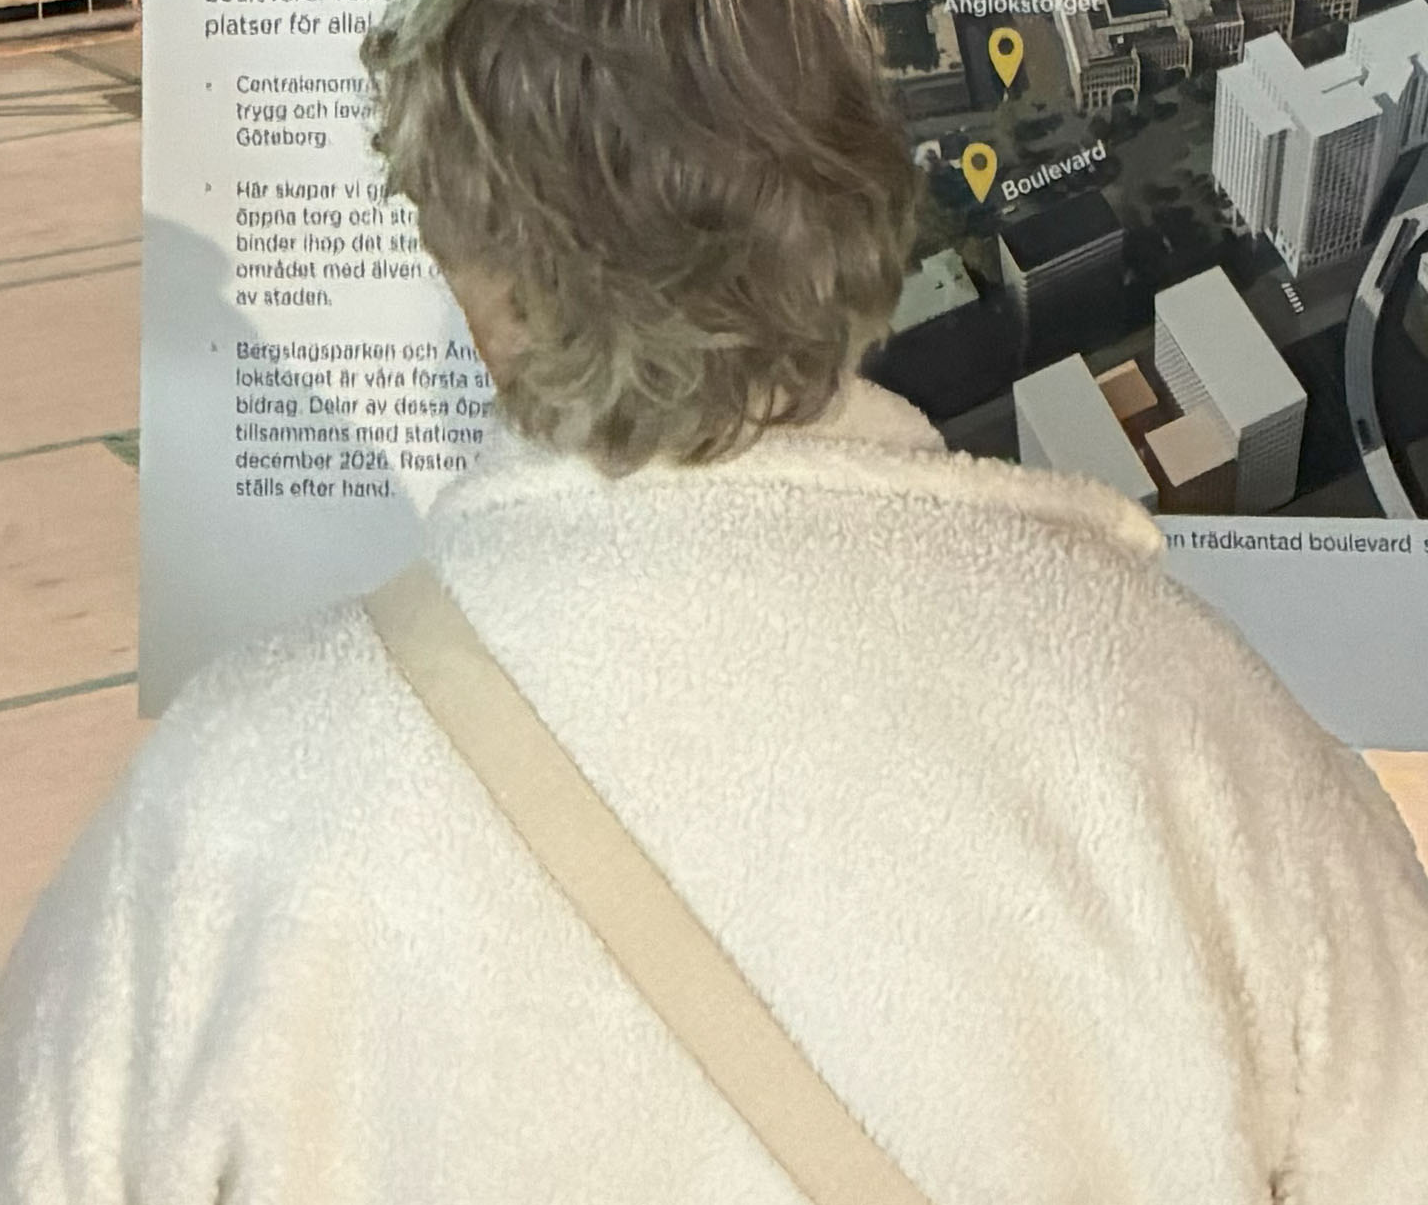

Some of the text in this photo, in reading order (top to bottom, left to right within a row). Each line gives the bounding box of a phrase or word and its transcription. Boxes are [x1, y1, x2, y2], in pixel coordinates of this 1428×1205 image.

[205, 14, 281, 39] platser
[289, 12, 322, 35] för
[294, 100, 328, 118] och
[1001, 139, 1107, 201] Boulevard
[236, 181, 268, 198] Här
[275, 180, 337, 201] skapar
[344, 180, 360, 198] vi
[236, 209, 296, 228] öppna
[302, 207, 342, 228] torg
[348, 207, 384, 226] och
[236, 234, 296, 254] binder
[351, 233, 382, 252] det
[236, 259, 316, 279] området
[323, 259, 366, 279] med
[372, 259, 422, 279] älven
[236, 291, 257, 306] av
[236, 342, 396, 363] Bergslagsparken
[402, 341, 438, 361] och
[236, 370, 332, 392] lokstorget
[339, 370, 357, 388] är
[365, 368, 405, 389] våra
[412, 367, 468, 389] första
[309, 395, 358, 415] Delar
[365, 399, 387, 415] av
[394, 395, 449, 417] dessa
[236, 424, 349, 444] tillsammans
[356, 423, 399, 444] med
[236, 450, 332, 470] december
[400, 449, 467, 471] Resten
[236, 477, 284, 497] ställs
[290, 477, 334, 497] efter
[1191, 530, 1302, 551] trädkantad
[1309, 532, 1411, 553] boulevard
